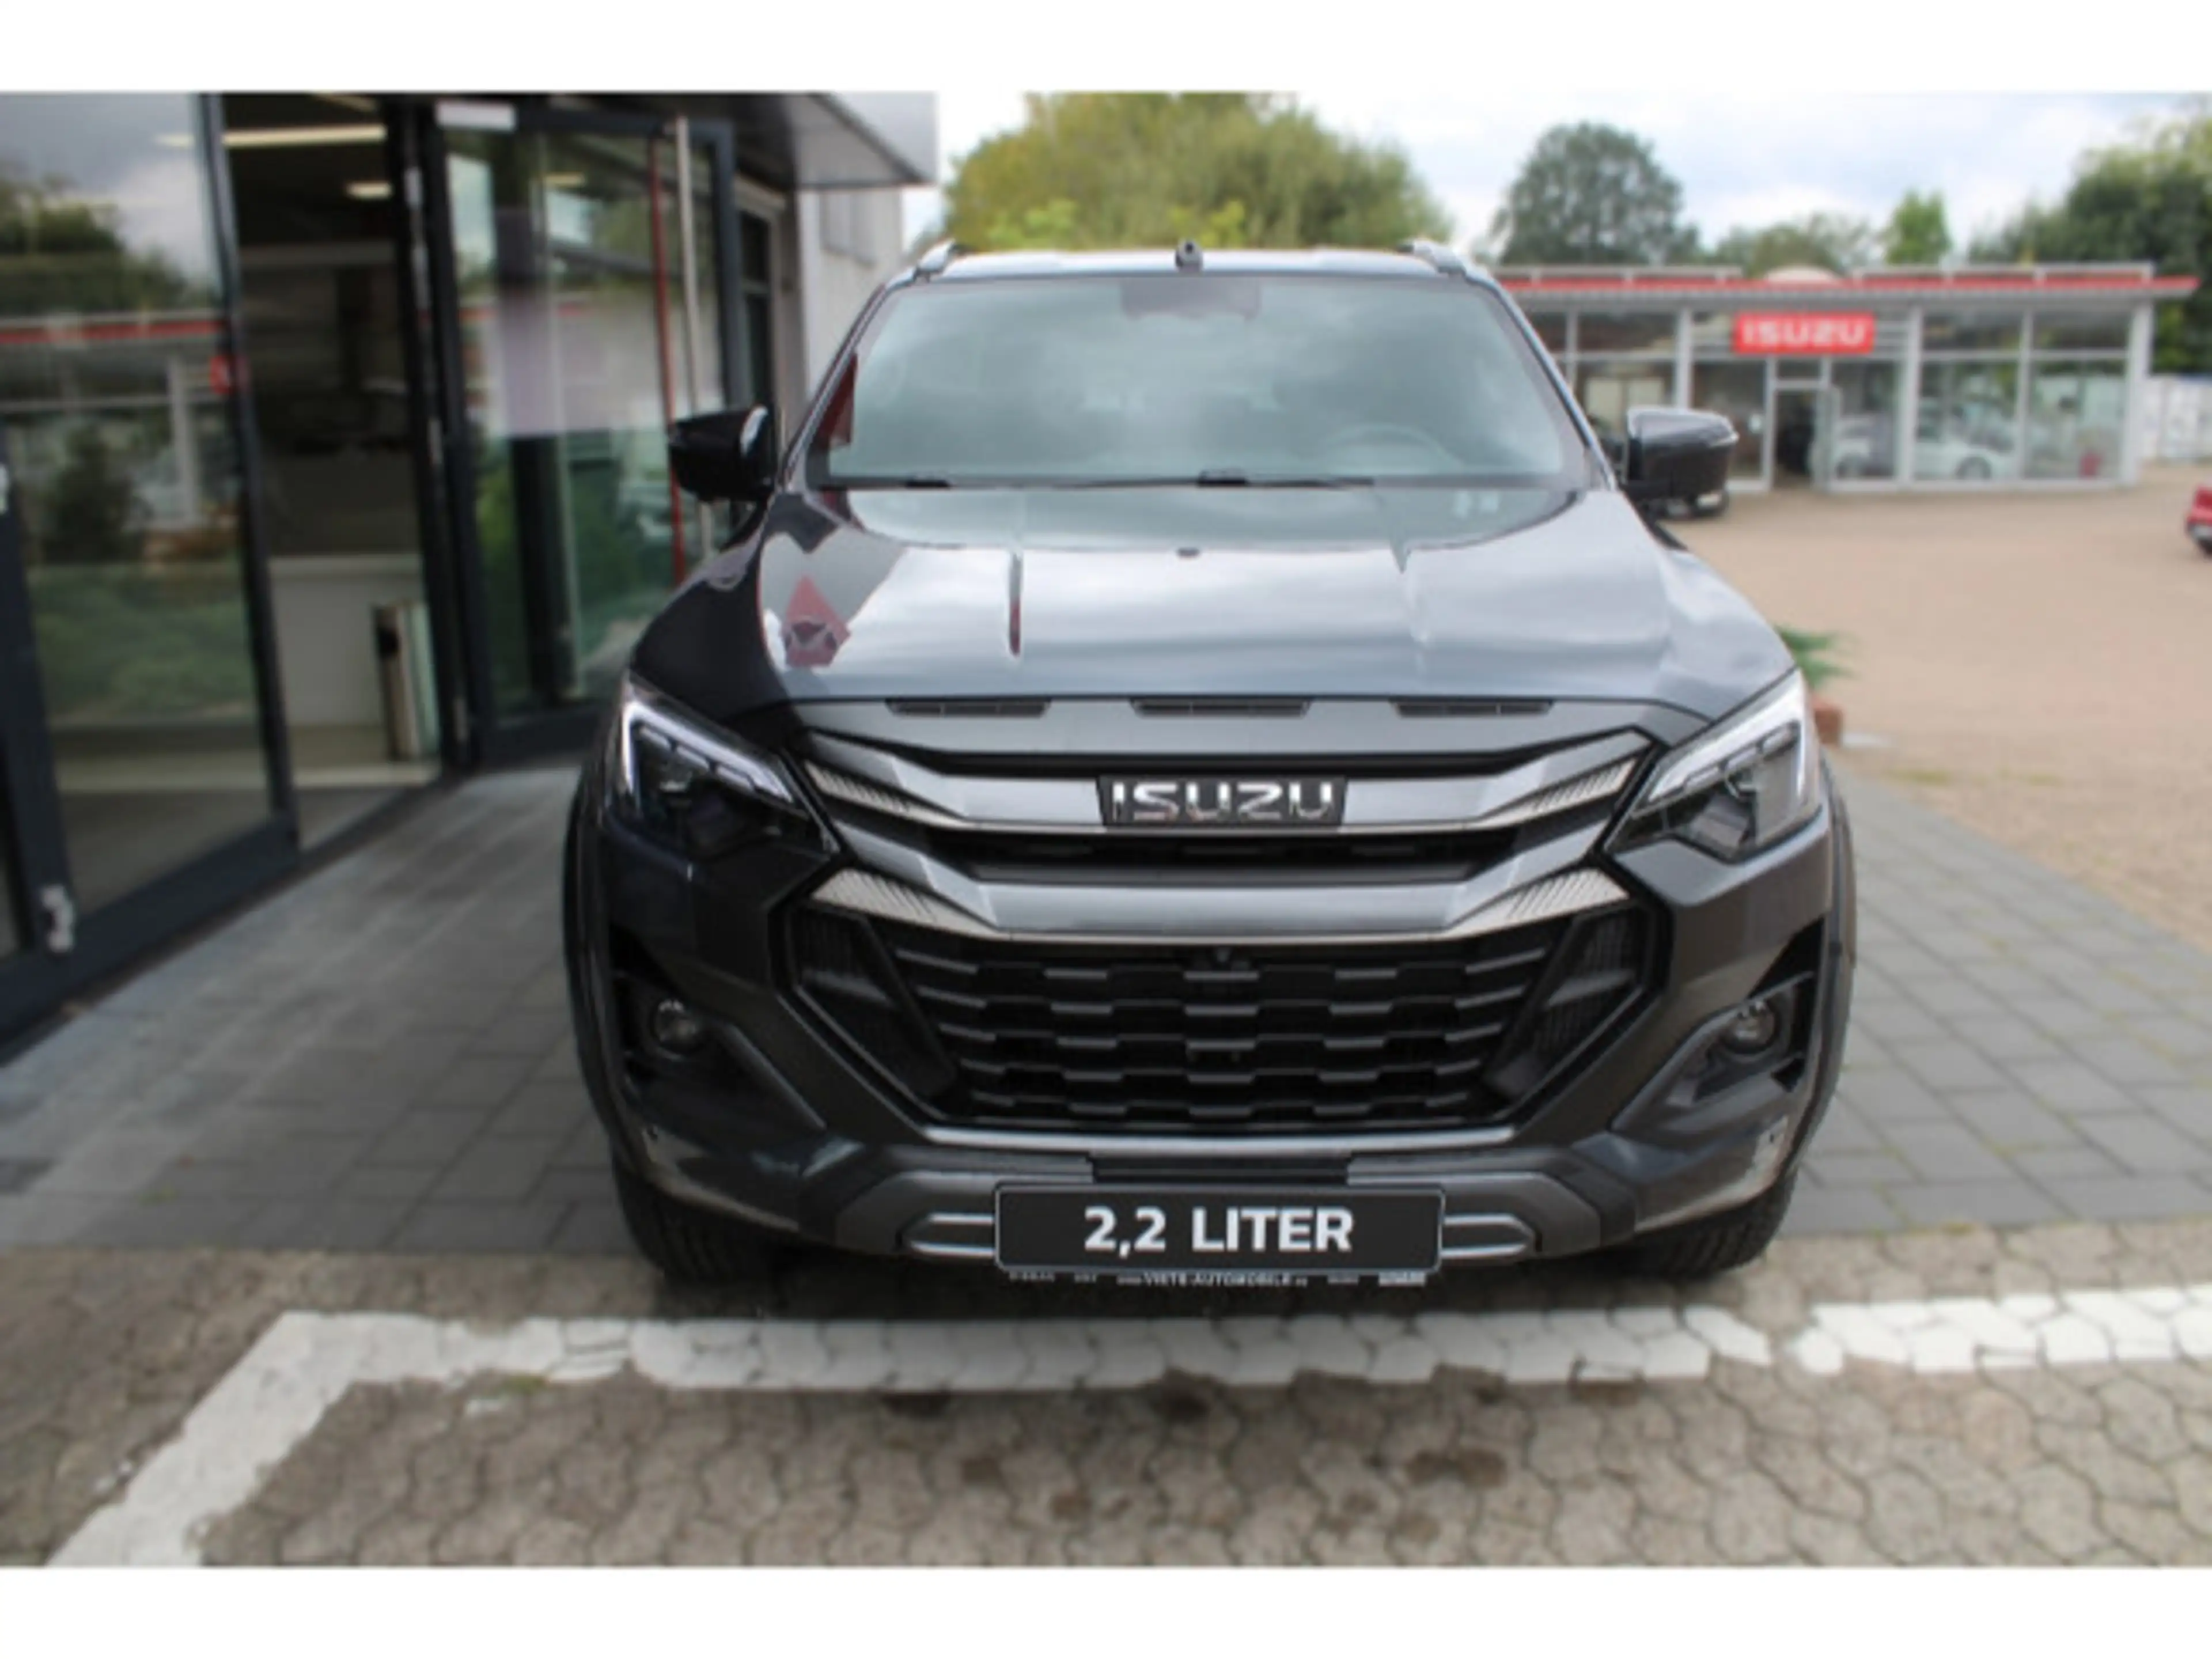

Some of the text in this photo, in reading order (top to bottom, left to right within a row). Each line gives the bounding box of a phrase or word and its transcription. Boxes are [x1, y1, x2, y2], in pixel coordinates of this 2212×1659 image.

[1742, 320, 1865, 346] ISUZU
[1112, 782, 1333, 821] ISUZU
[1084, 1207, 1354, 1257] 2,2 LITER
